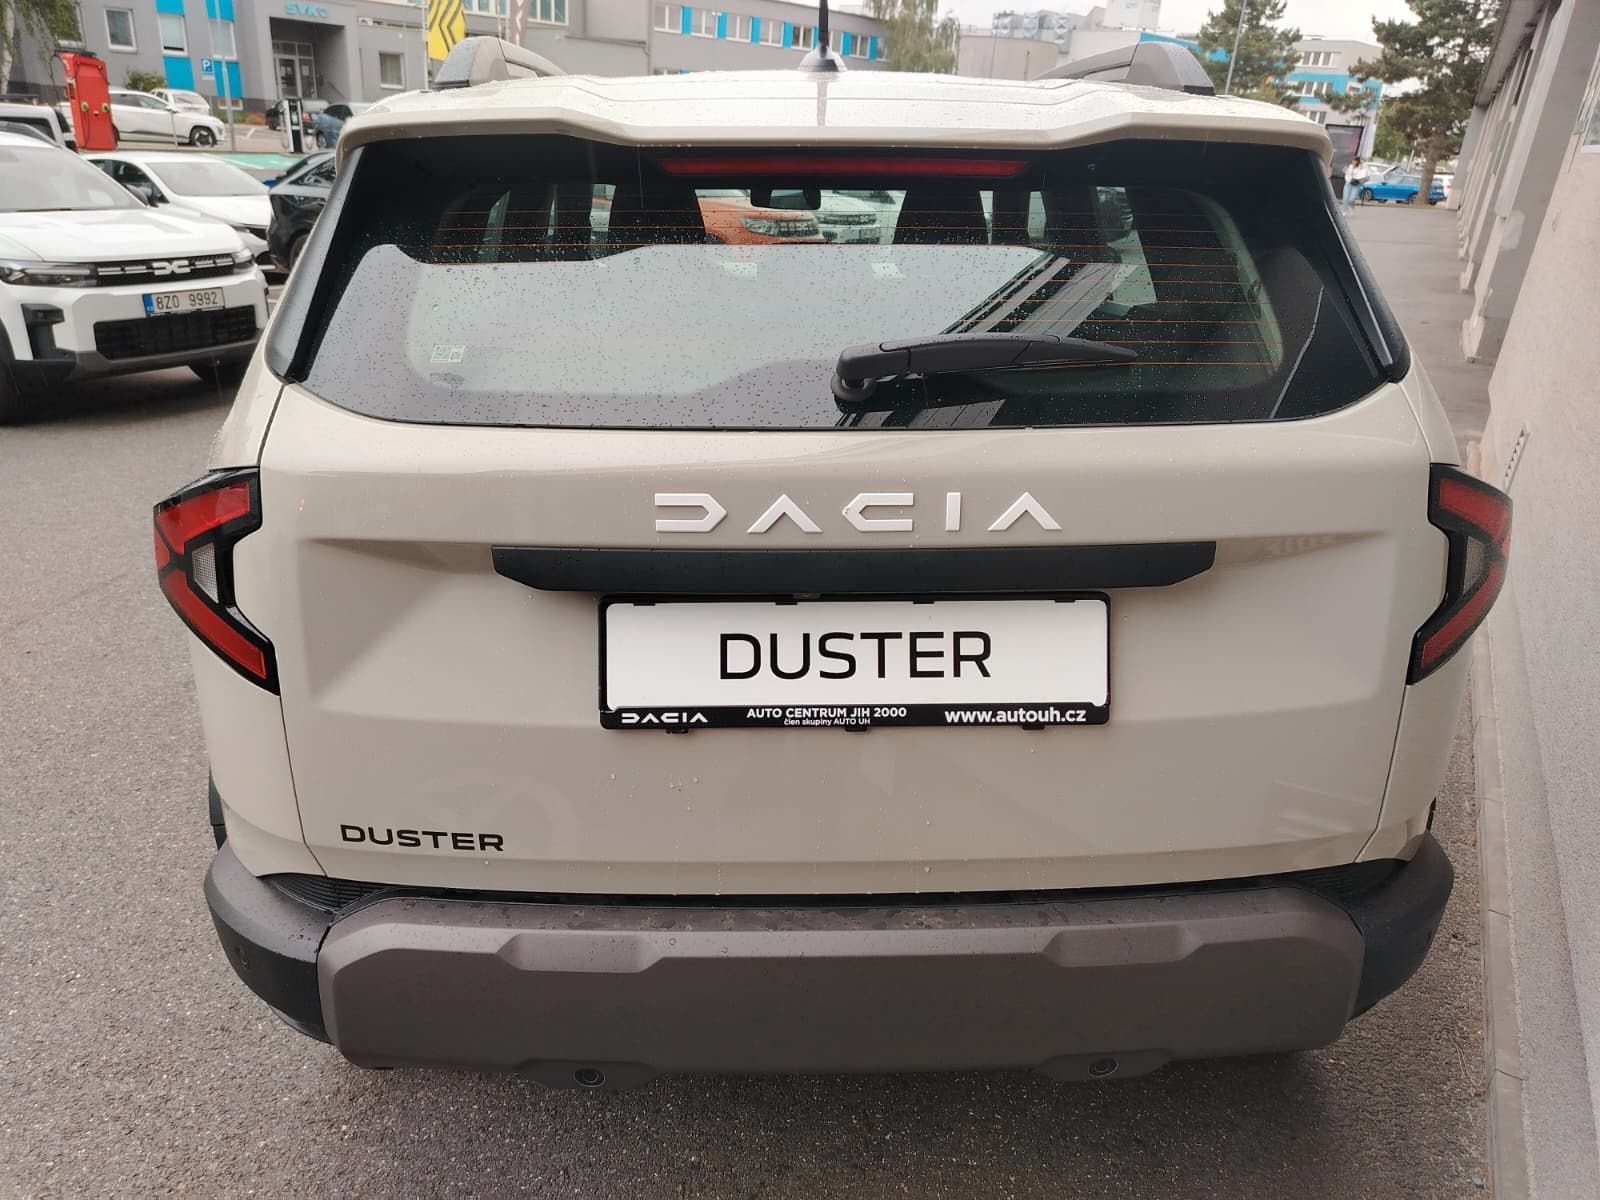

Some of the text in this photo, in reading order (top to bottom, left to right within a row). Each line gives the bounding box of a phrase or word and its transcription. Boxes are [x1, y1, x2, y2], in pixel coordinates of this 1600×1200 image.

[203, 60, 211, 71] P
[189, 292, 218, 307] 9992
[654, 491, 1062, 533] DACIA
[719, 631, 992, 680] DUSTER
[621, 712, 709, 724] DACIA
[747, 706, 907, 719] AUTO CENTRUM JIH 2000
[944, 706, 1087, 723] www.autouh.cz
[833, 718, 857, 726] AUTO
[858, 717, 871, 726] UH
[340, 824, 504, 852] DUSTER
